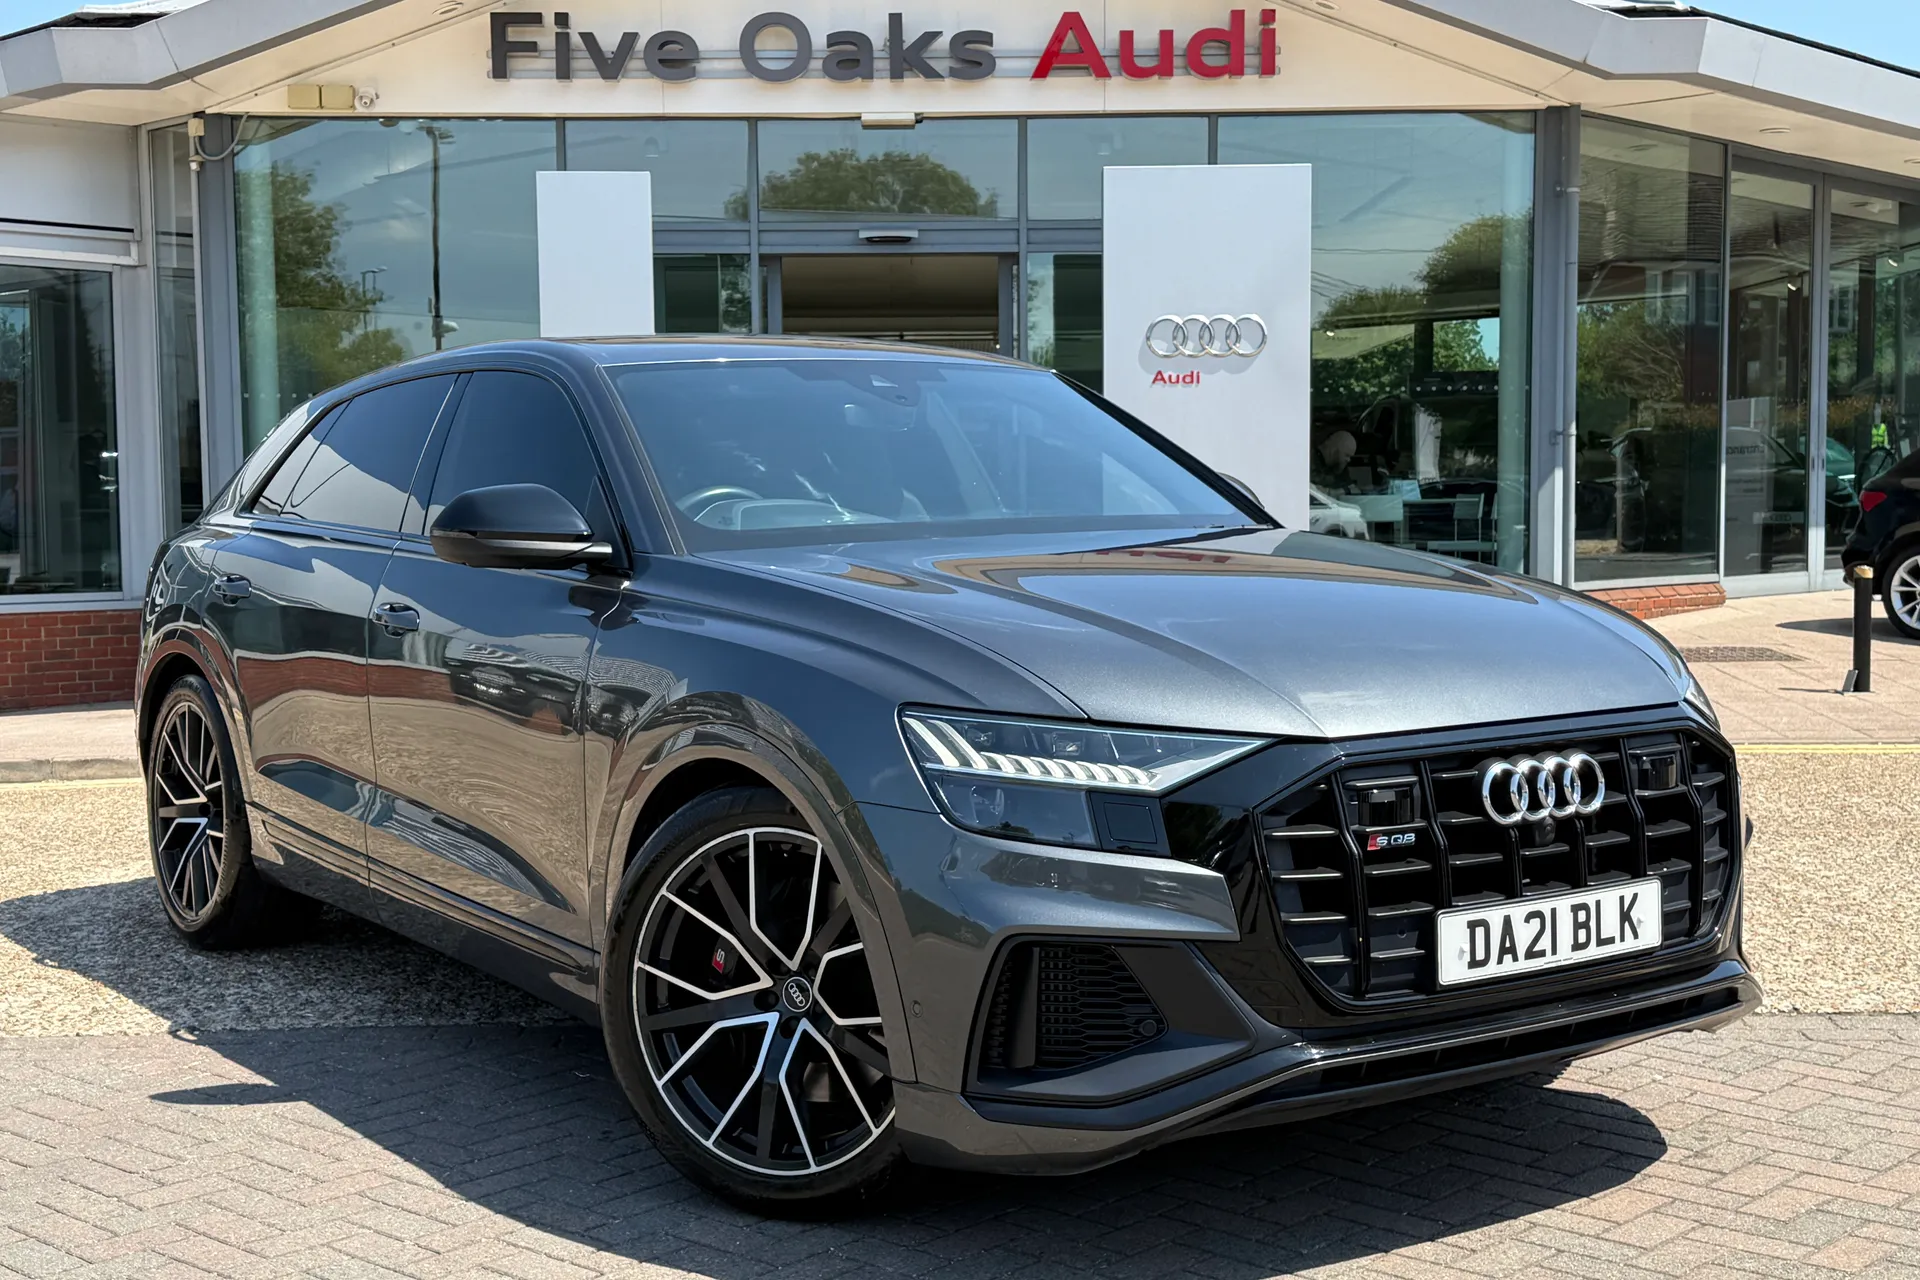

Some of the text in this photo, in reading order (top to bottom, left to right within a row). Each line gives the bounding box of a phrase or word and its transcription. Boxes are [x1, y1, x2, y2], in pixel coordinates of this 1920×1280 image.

[488, 9, 1278, 83] Five Oaks Audi
[1151, 370, 1201, 386] Audi
[1466, 892, 1639, 970] DA21 BLK
